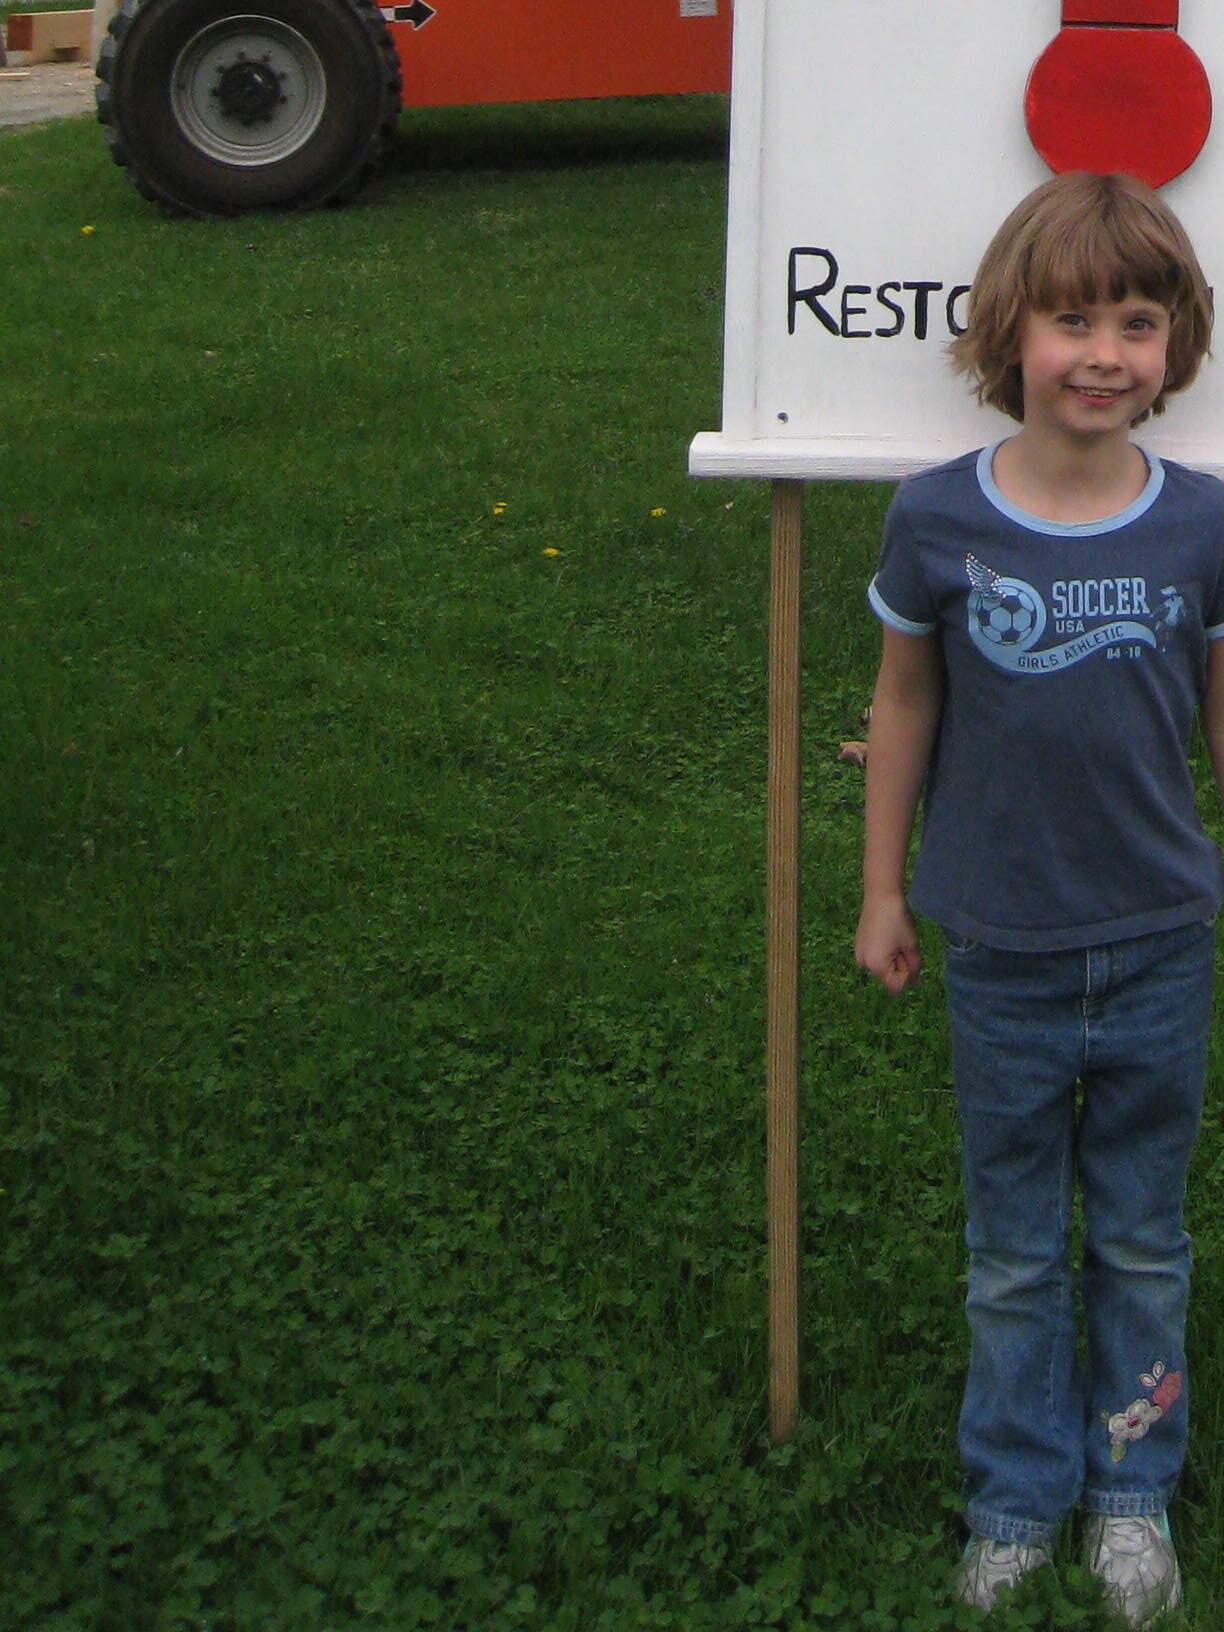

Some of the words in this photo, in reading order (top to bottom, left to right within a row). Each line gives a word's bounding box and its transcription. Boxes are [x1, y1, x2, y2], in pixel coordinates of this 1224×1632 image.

[1051, 576, 1151, 618] SOCCER
[1017, 653, 1059, 669] GIRLS
[1064, 625, 1125, 662] ATHLETIC
[1055, 620, 1085, 633] USA
